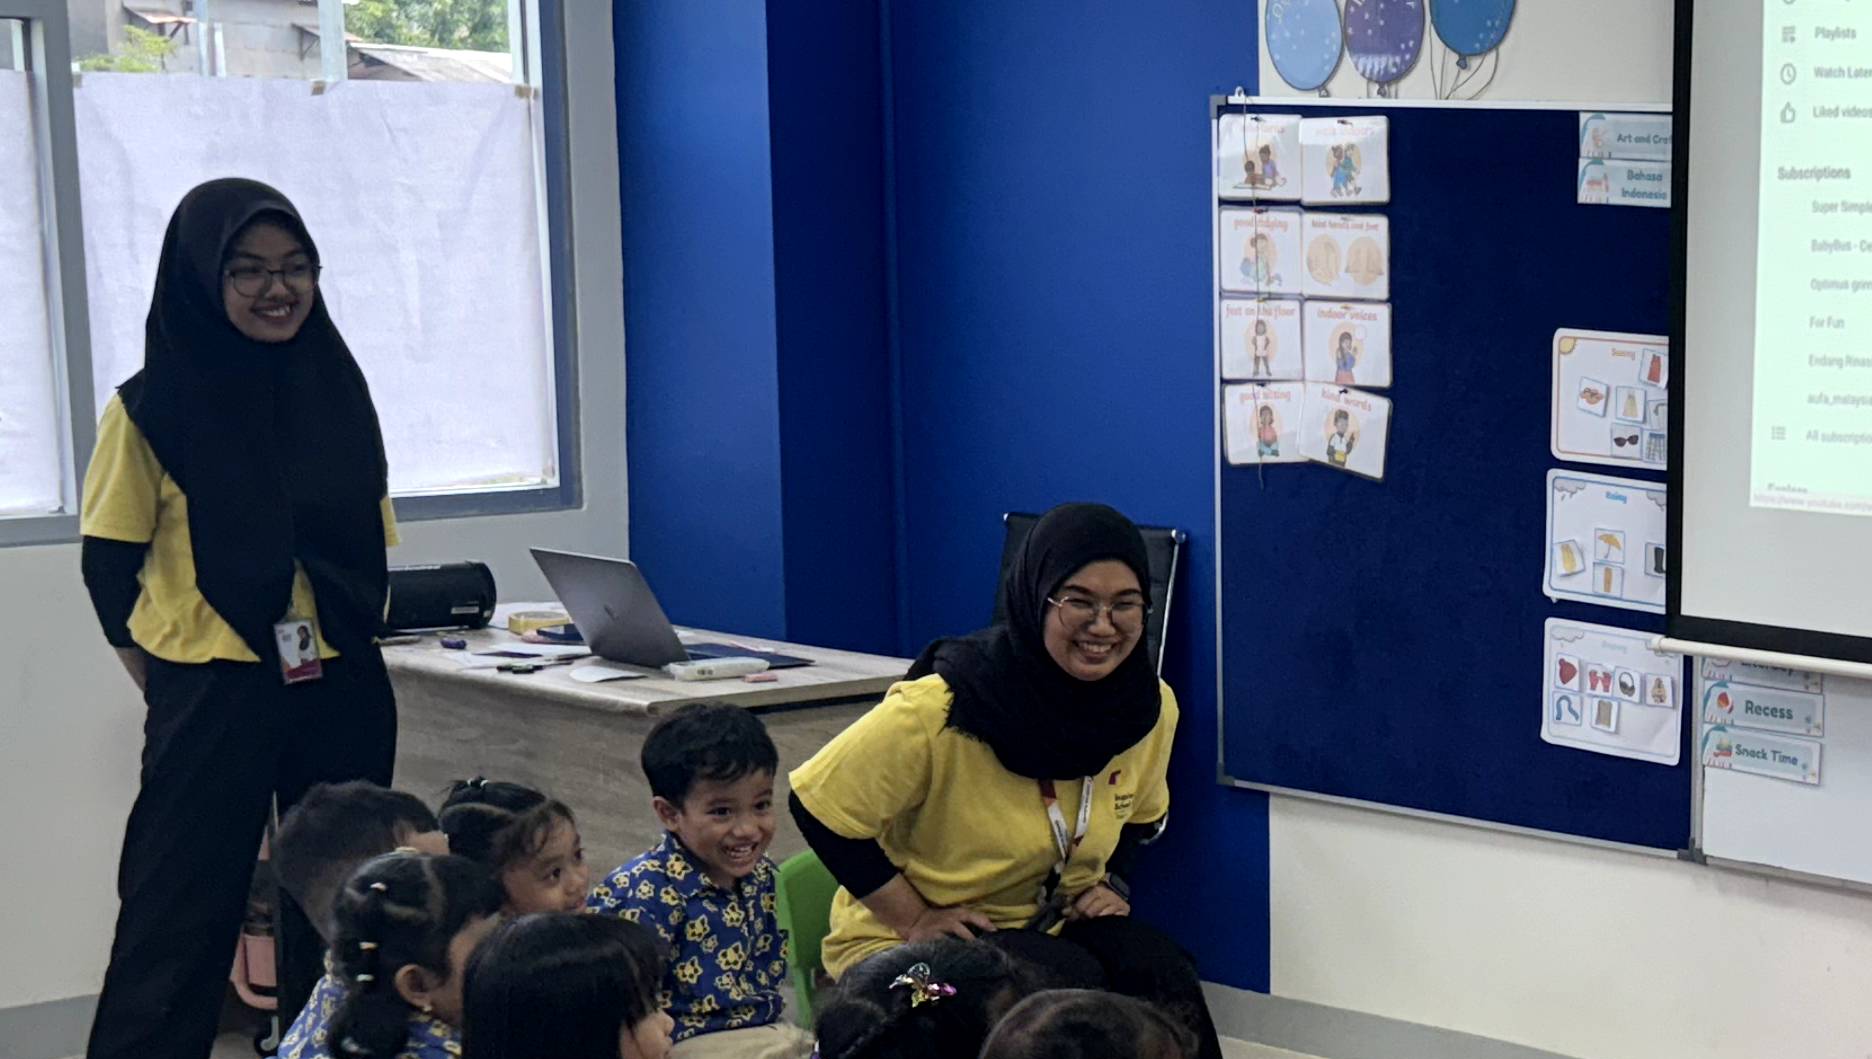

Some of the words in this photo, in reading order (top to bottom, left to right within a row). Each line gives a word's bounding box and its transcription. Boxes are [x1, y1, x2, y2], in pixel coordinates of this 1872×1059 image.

[1814, 26, 1857, 41] Playlists
[1814, 66, 1845, 79] Watch
[1813, 104, 1840, 119] Liked
[1616, 132, 1633, 144] Art
[1634, 133, 1651, 144] and
[1626, 168, 1663, 182] Bahasa
[1777, 165, 1851, 182] Subscriptions
[1621, 187, 1667, 201] Indonesia
[1811, 200, 1839, 216] Super
[1826, 316, 1845, 329] Fun
[1806, 430, 1819, 442] All
[1744, 699, 1794, 720] Recess
[1735, 743, 1768, 760] Snack
[1770, 749, 1799, 766] Time
